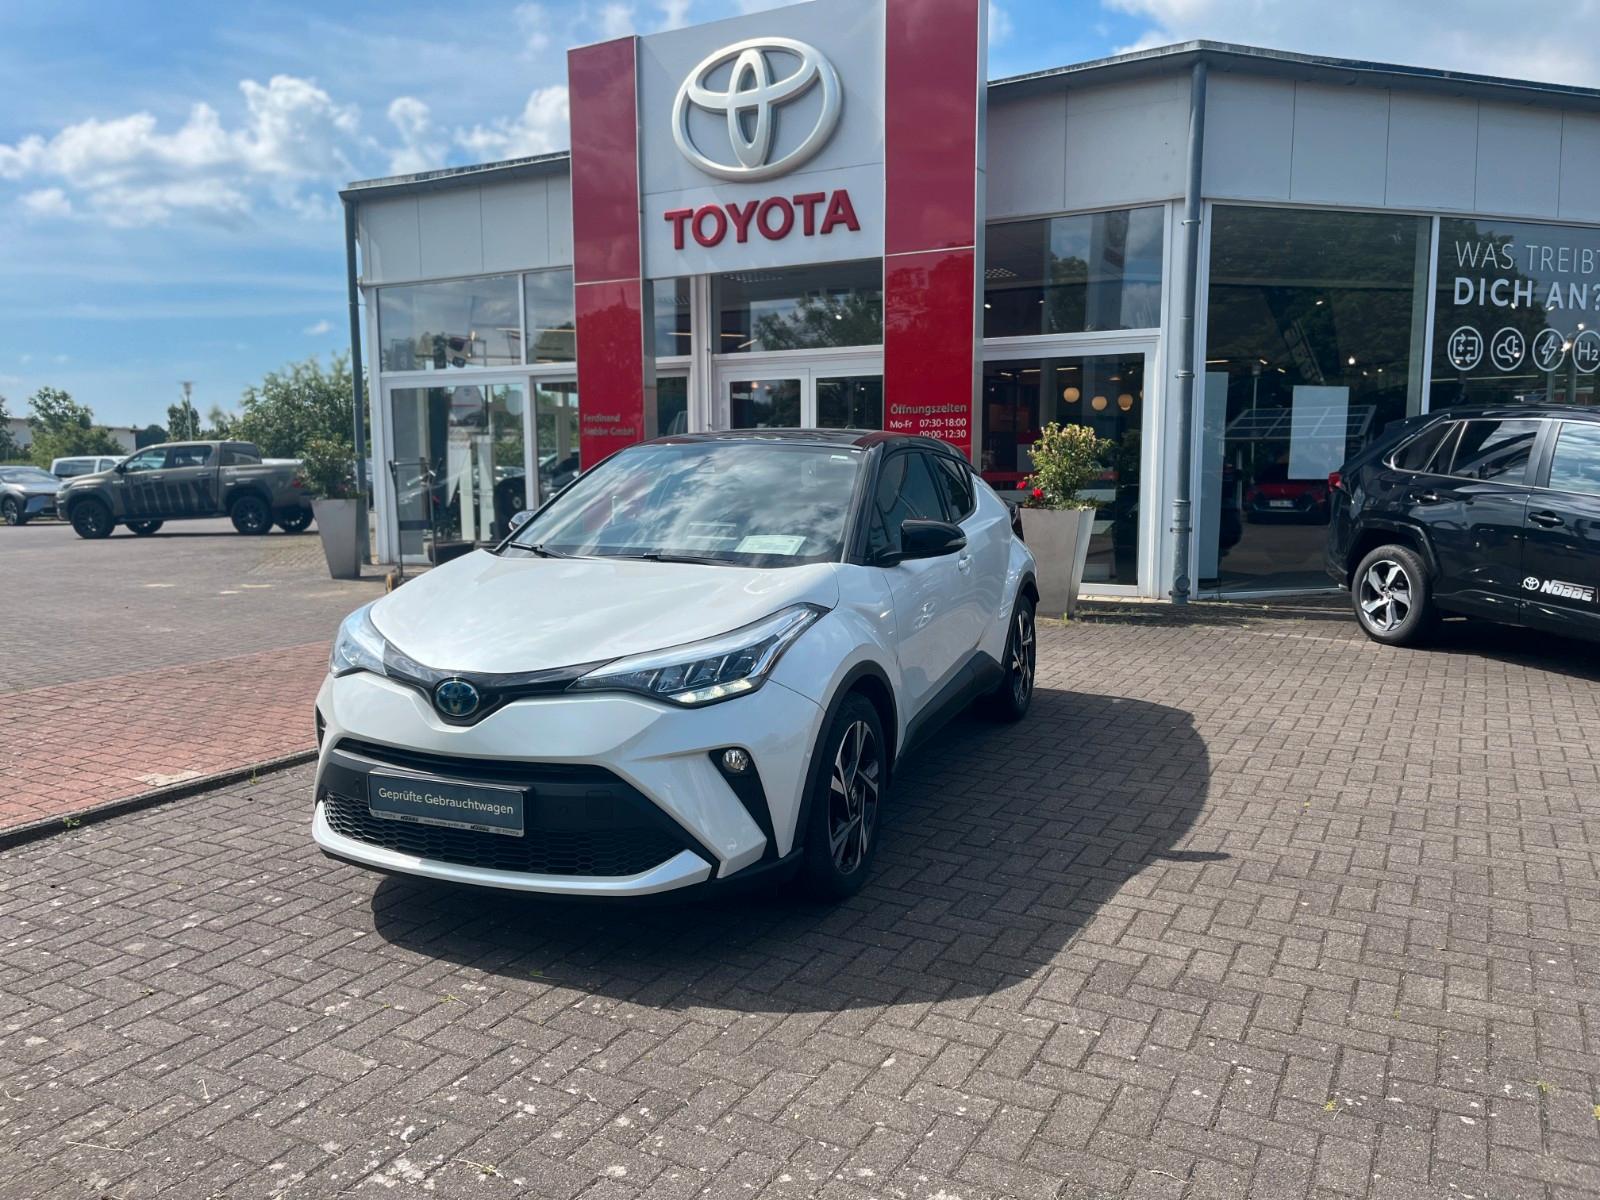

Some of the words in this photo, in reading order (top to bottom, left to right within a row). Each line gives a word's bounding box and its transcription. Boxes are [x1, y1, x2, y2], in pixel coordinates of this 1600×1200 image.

[664, 189, 861, 250] TOYOTA
[1455, 240, 1514, 270] WAS
[1525, 244, 1600, 274] TREIB
[1454, 277, 1533, 308] DICH
[1545, 281, 1600, 311] AN?
[890, 403, 967, 416] Öffnungszeiten
[890, 420, 912, 429] Mo-Fr
[919, 418, 967, 428] 07:30-18:00
[378, 788, 422, 804] Geprüfte
[424, 793, 514, 815] Gebrauchtwagen
